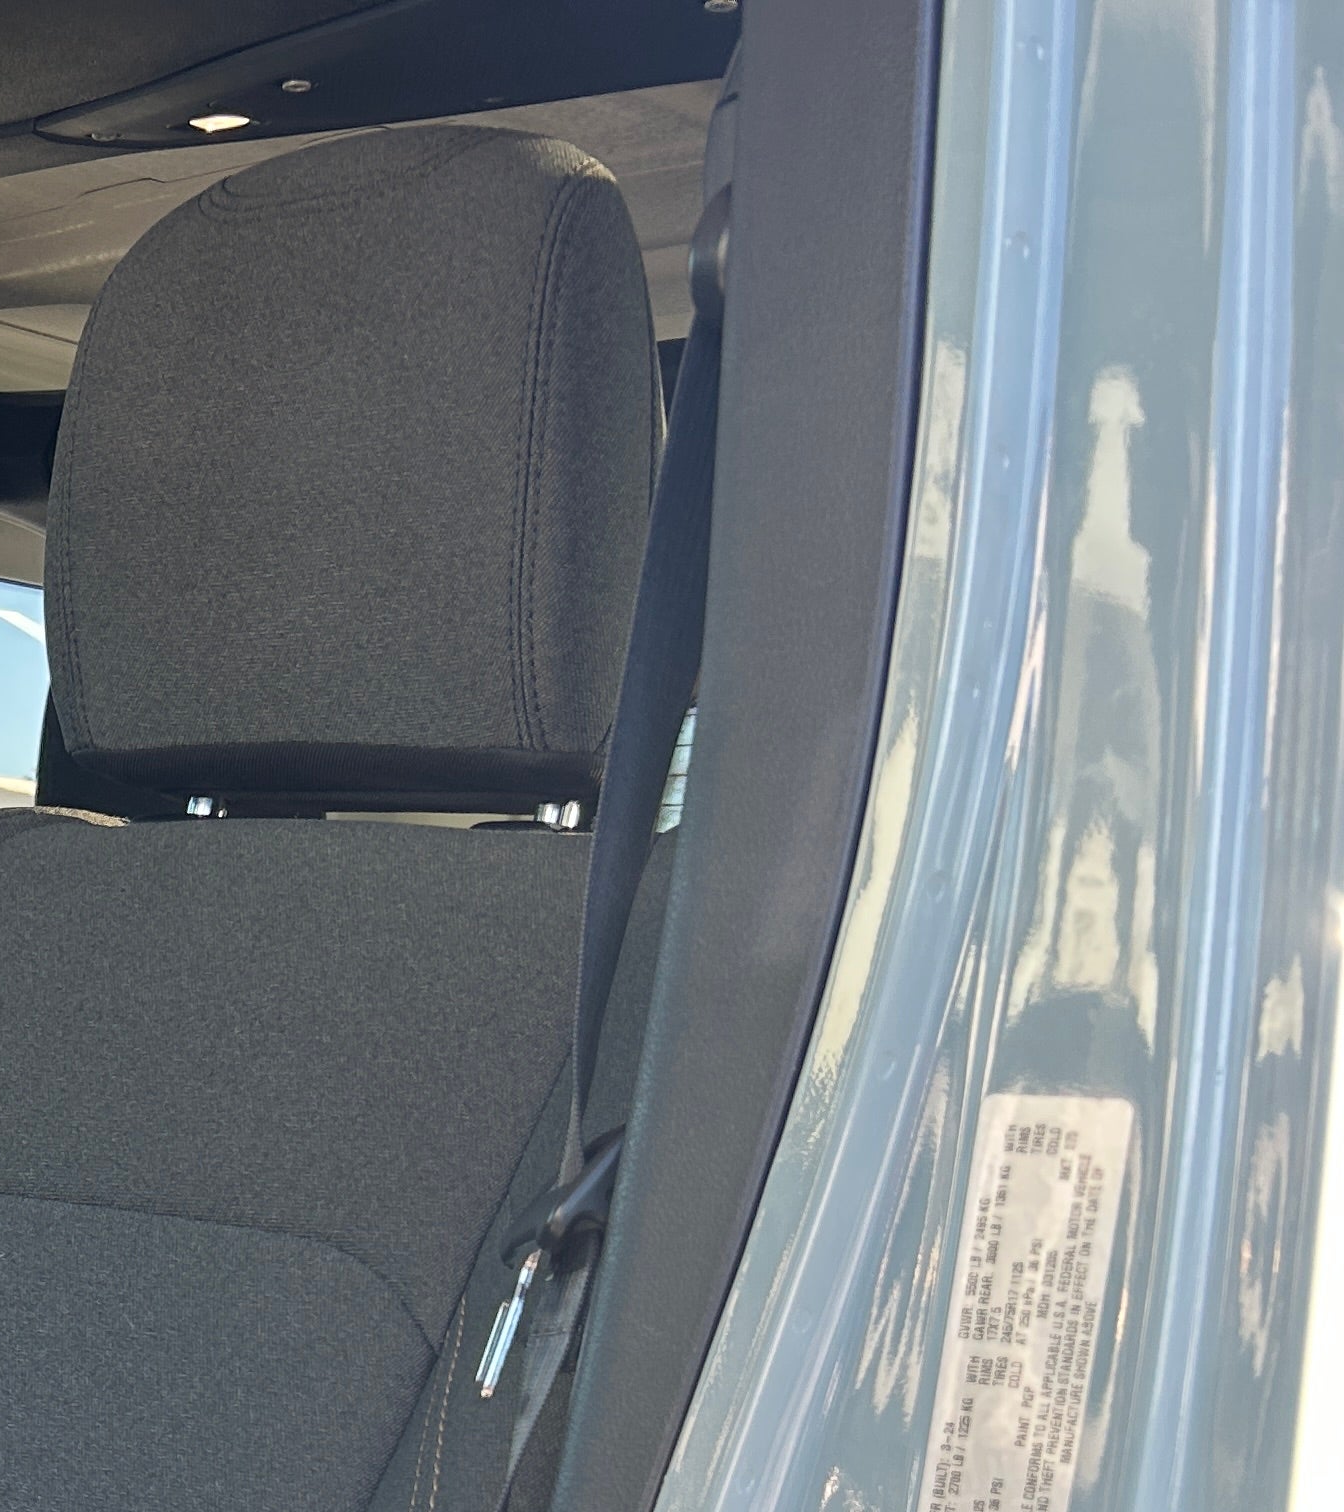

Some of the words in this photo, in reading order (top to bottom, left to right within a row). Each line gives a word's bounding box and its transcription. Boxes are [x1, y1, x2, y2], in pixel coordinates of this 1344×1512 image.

[1003, 1124, 1017, 1152] WITH
[1015, 1126, 1031, 1154] RIMS
[1030, 1123, 1046, 1154] TIRES
[999, 1165, 1011, 1180] KG
[1073, 1153, 1092, 1198] VEHICLE
[1085, 1185, 1102, 1212] DATE
[969, 1255, 982, 1267] LB
[978, 1198, 991, 1213] KG
[989, 1223, 1002, 1235] LB
[1066, 1202, 1083, 1240] MOTOR
[1014, 1331, 1026, 1345] AT
[1046, 1127, 1062, 1155] COLD
[1078, 1241, 1092, 1257] ON
[1057, 1244, 1077, 1293] FEDERAL
[1070, 1261, 1088, 1301] EFFECT
[972, 1308, 988, 1340] GAWR
[1069, 1304, 1081, 1315] IN
[1080, 1300, 1097, 1336] ABOVE
[1040, 1333, 1062, 1398] APPLICABLE
[1056, 1319, 1079, 1385] STANDARDS
[1073, 1338, 1090, 1380] SHOWN
[965, 1355, 980, 1383] WITH
[978, 1358, 993, 1385] RIMS
[992, 1356, 1008, 1386] TIRES
[1007, 1360, 1023, 1389] COLD
[961, 1397, 974, 1412] KG
[1036, 1402, 1051, 1421] ALL
[1032, 1424, 1047, 1438] TO
[1045, 1387, 1068, 1455] PREVENTION
[1059, 1383, 1083, 1464] MANUFACTURE
[952, 1454, 965, 1467] LB
[1022, 1442, 1043, 1500] CONFORMS
[947, 1470, 962, 1495] 2700
[990, 1477, 1004, 1495] PSI
[1038, 1459, 1055, 1493] THEFT
[988, 1498, 1000, 1511] 36
